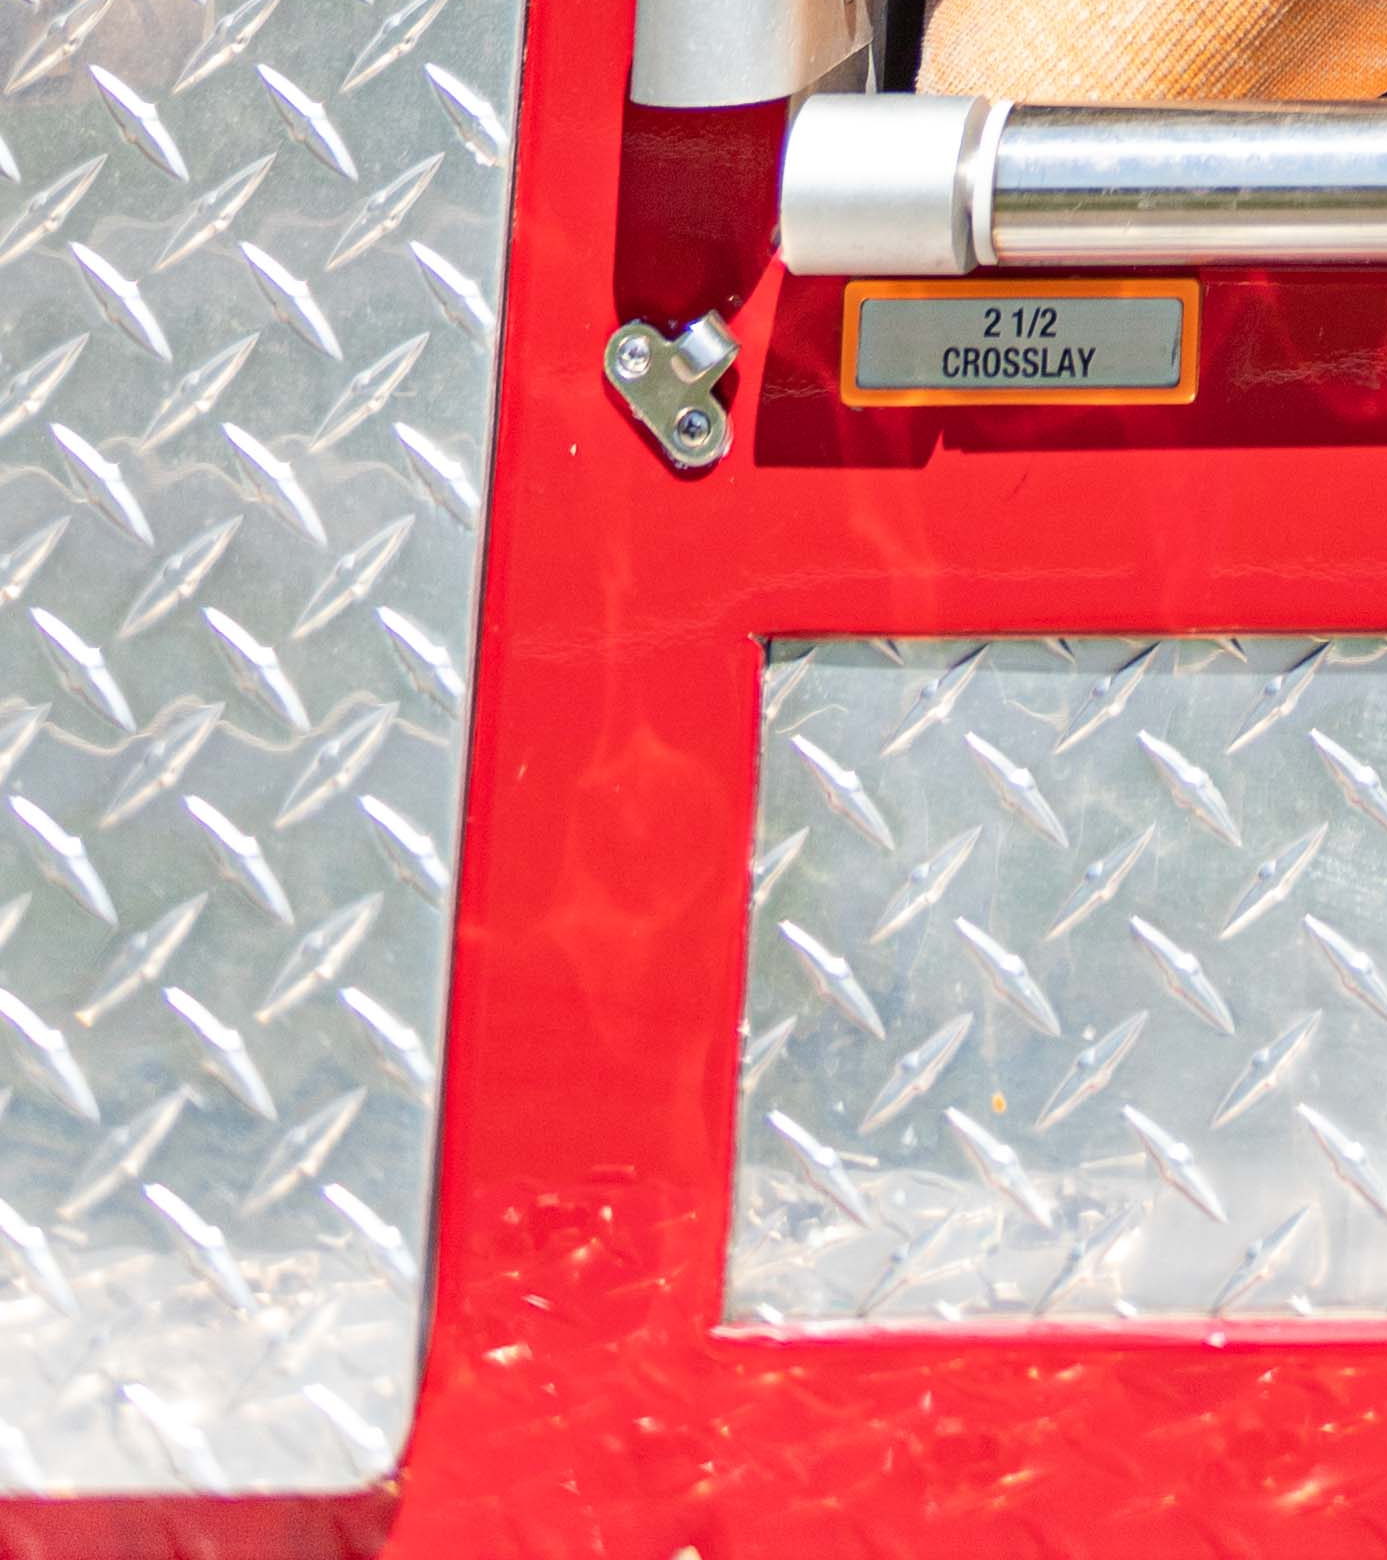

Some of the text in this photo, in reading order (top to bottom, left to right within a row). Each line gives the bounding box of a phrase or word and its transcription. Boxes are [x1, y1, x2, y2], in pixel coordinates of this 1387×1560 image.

[984, 307, 1058, 338] 2 1/2
[942, 347, 1097, 378] CROSSLAY
